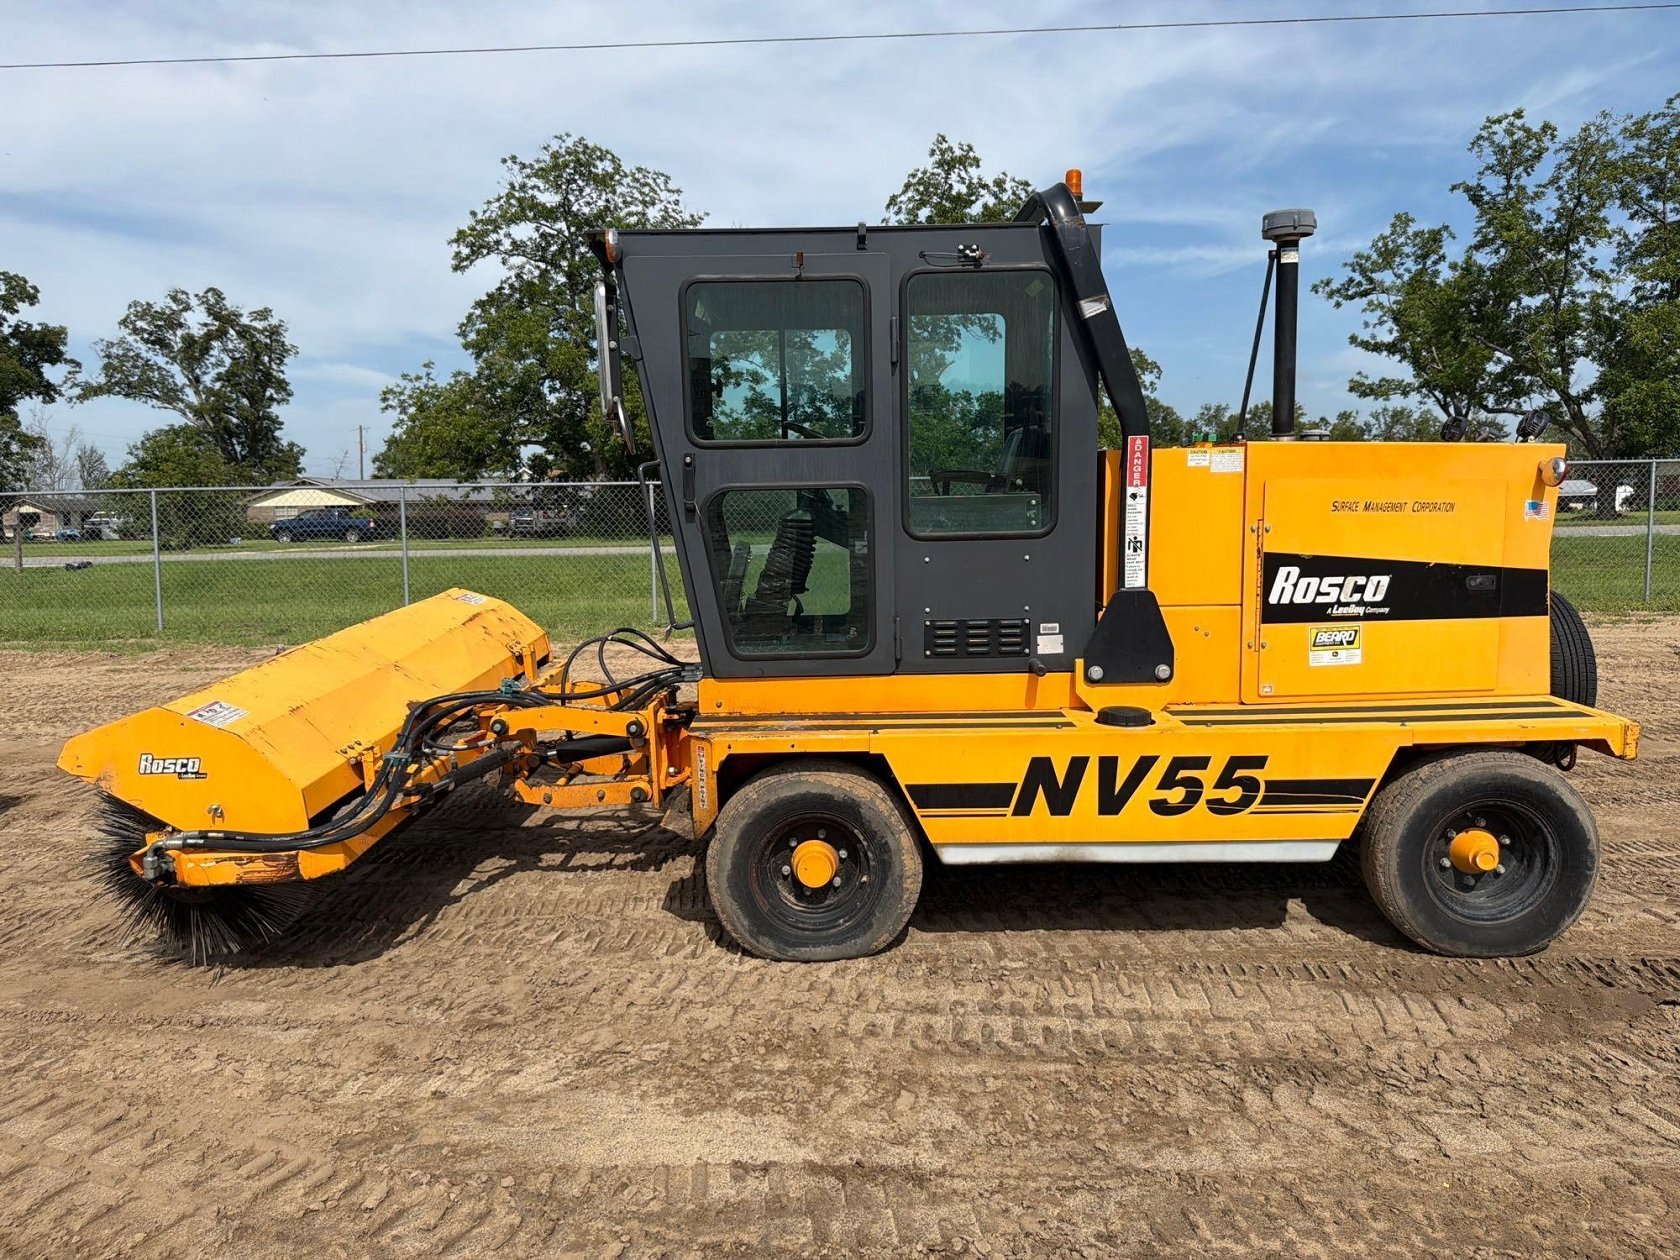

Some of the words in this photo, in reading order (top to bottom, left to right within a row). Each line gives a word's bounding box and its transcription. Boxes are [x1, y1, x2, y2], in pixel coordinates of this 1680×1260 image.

[1133, 444, 1142, 487] DANGER
[1331, 500, 1360, 513] SURFACE
[1362, 500, 1408, 513] MANAGEMENT
[1411, 500, 1456, 513] CORPORATION
[1332, 604, 1365, 616] LeeBoy
[1365, 606, 1390, 614] Company
[1315, 630, 1356, 646] BEARD
[1011, 754, 1269, 817] NV55
